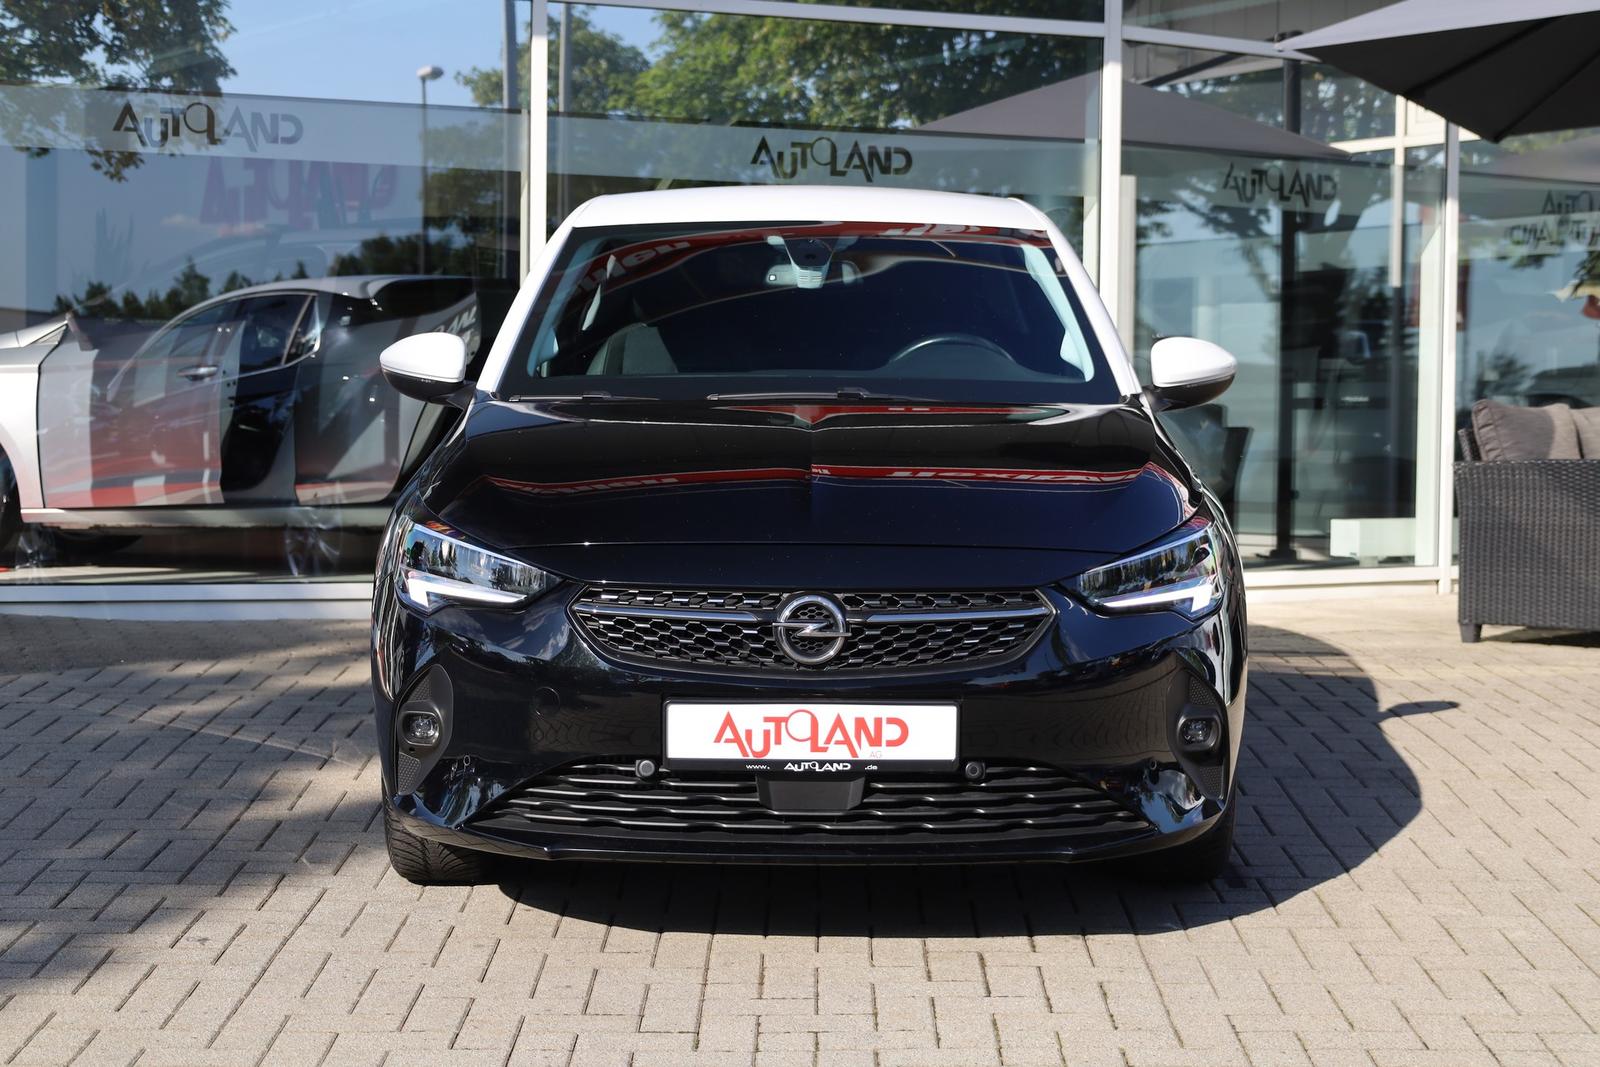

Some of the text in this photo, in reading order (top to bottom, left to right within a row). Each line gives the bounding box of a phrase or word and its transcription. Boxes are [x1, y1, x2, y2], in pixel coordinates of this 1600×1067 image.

[112, 101, 304, 152] AUTOLAND
[751, 135, 913, 183] AUTOLAND
[1222, 162, 1338, 208] AUTOLAND
[713, 709, 909, 758] AUTOLAND
[784, 761, 851, 772] AUTOLAND
